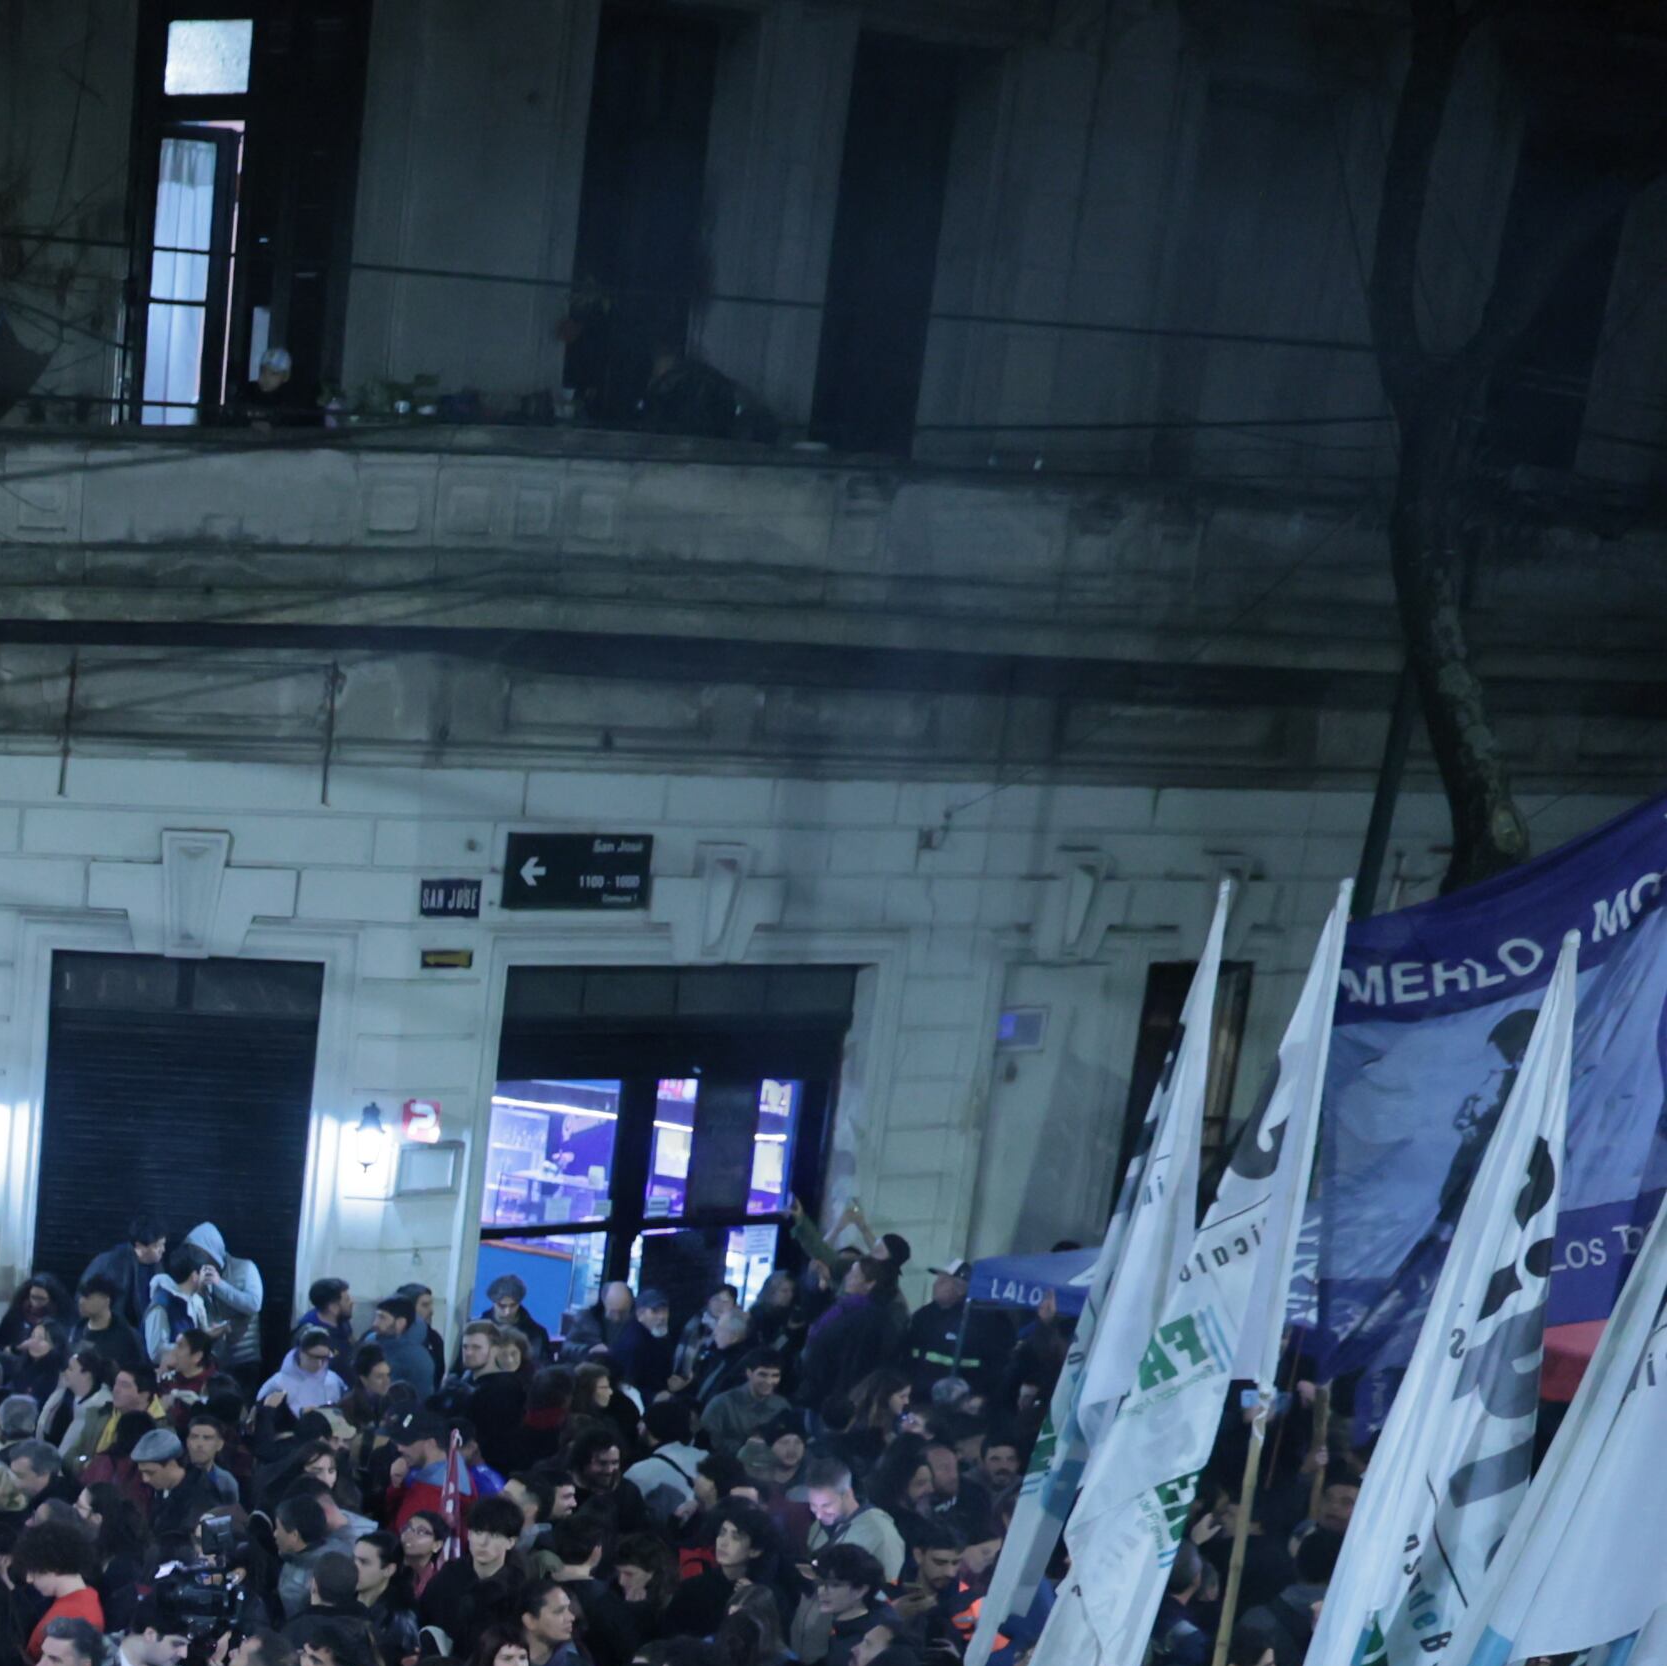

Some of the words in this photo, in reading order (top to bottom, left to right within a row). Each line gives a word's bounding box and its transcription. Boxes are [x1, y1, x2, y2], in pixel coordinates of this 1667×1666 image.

[593, 838, 615, 853] San
[422, 888, 446, 910] SAN
[1340, 937, 1544, 1005] MERLO
[1550, 1238, 1607, 1272] OS
